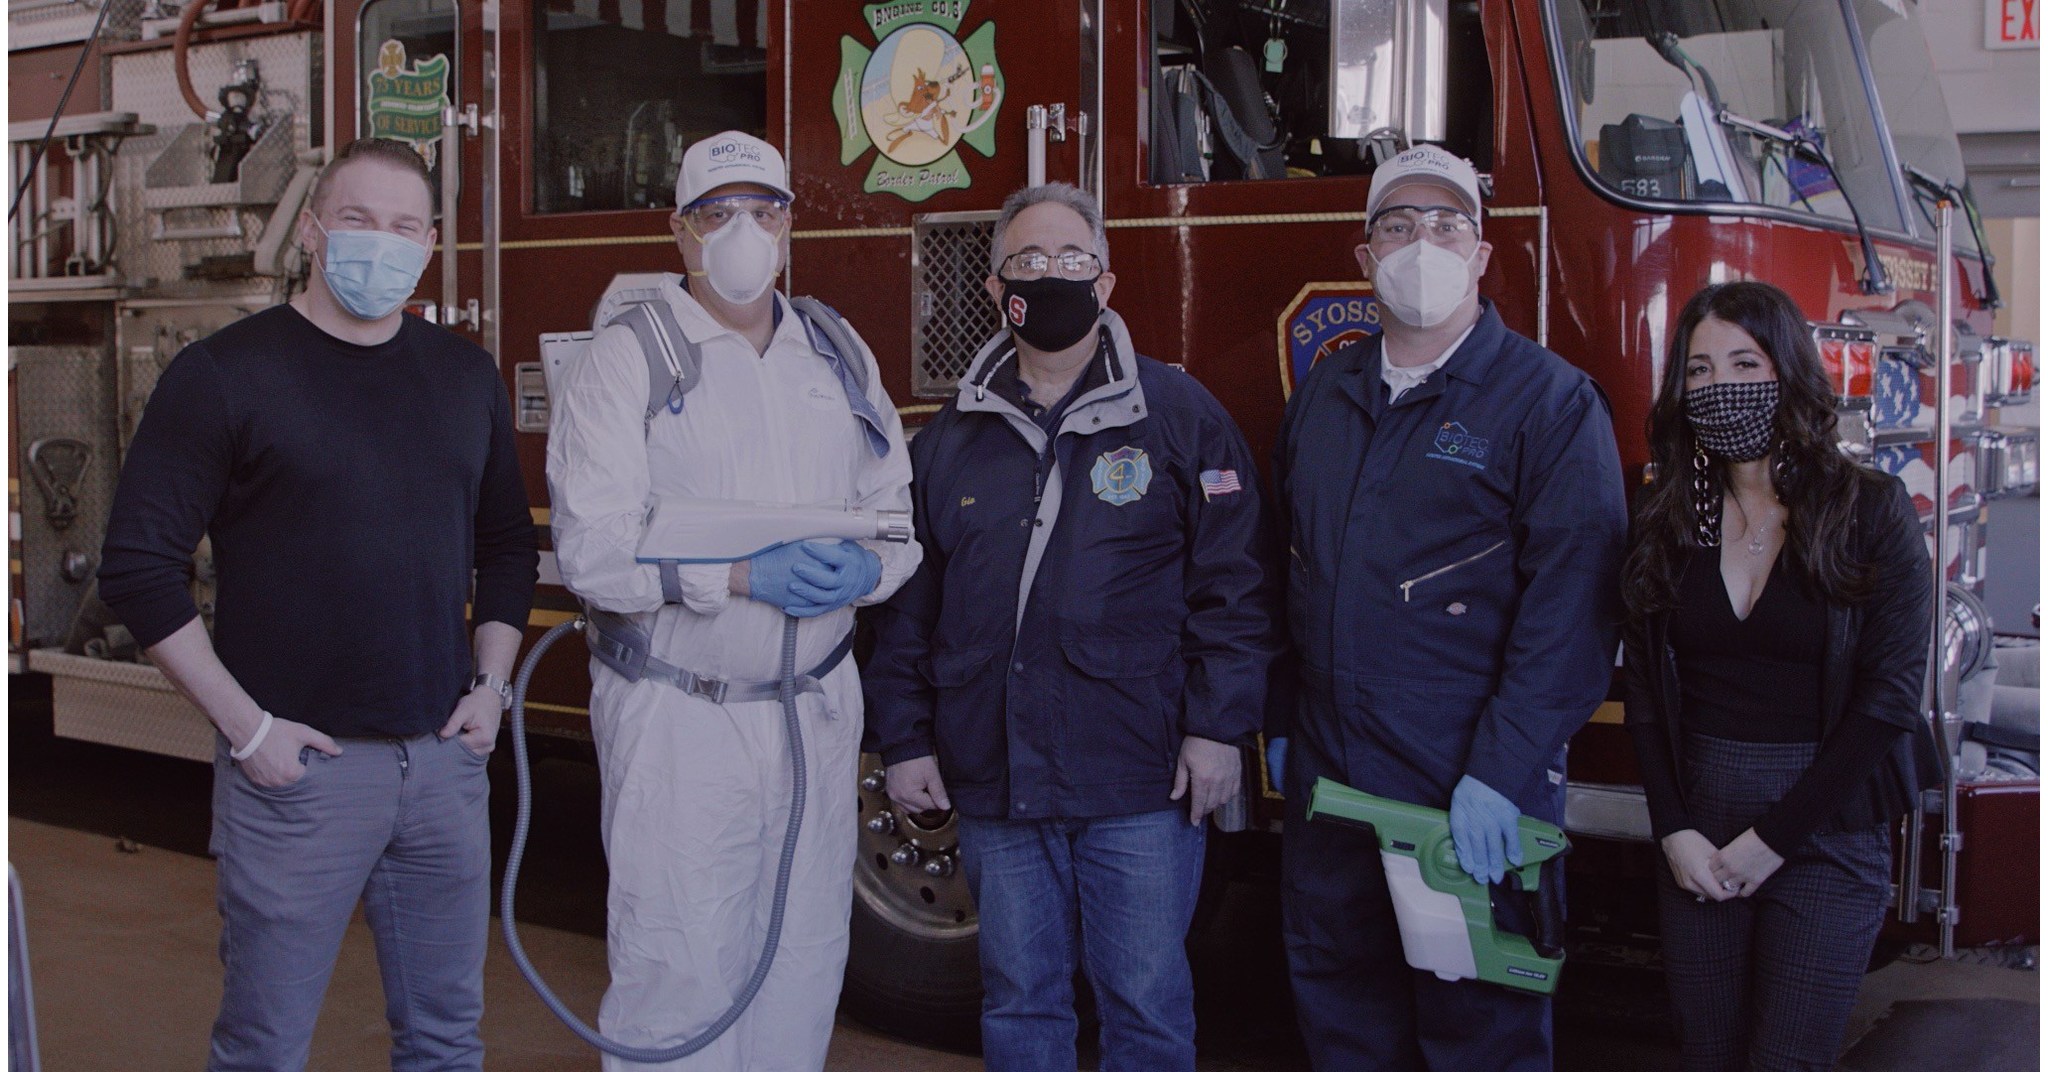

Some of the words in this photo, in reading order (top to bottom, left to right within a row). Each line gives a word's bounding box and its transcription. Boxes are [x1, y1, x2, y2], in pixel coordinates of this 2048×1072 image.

[873, 2, 923, 29] ENGINE
[2001, 0, 2040, 41] EX
[393, 78, 440, 97] YEARS
[711, 143, 760, 157] BIOTEC
[741, 153, 760, 161] PRO
[877, 171, 915, 188] Border
[919, 169, 960, 186] Patrol
[1620, 178, 1662, 198] 583
[1008, 294, 1028, 327] S
[1292, 300, 1380, 346] SYOSS
[1440, 431, 1488, 450] BIOTEC
[1461, 446, 1485, 459] PRO
